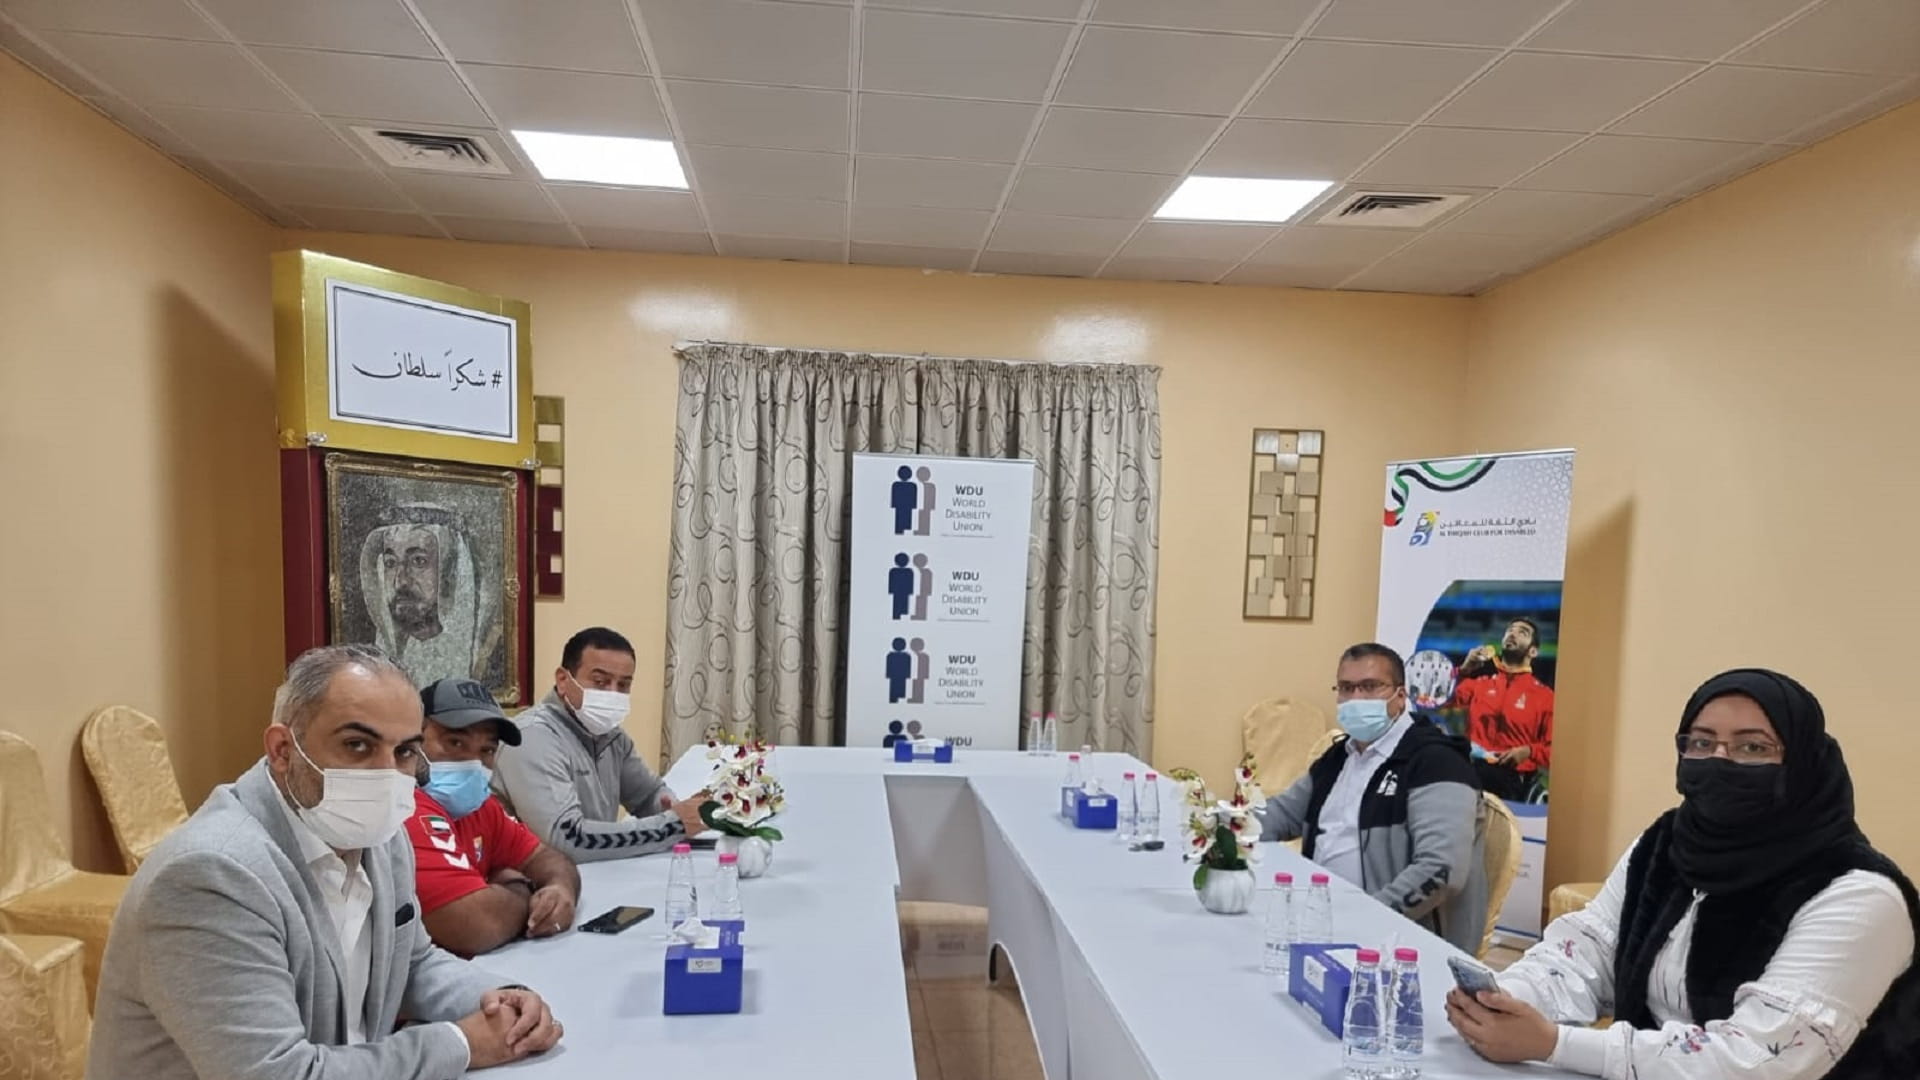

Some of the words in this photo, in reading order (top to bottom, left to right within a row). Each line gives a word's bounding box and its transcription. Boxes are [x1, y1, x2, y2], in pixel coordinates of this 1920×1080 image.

[352, 352, 442, 379] سلطان
[955, 484, 984, 496] WDU
[952, 571, 980, 581] WDU
[948, 655, 977, 665] WDU
